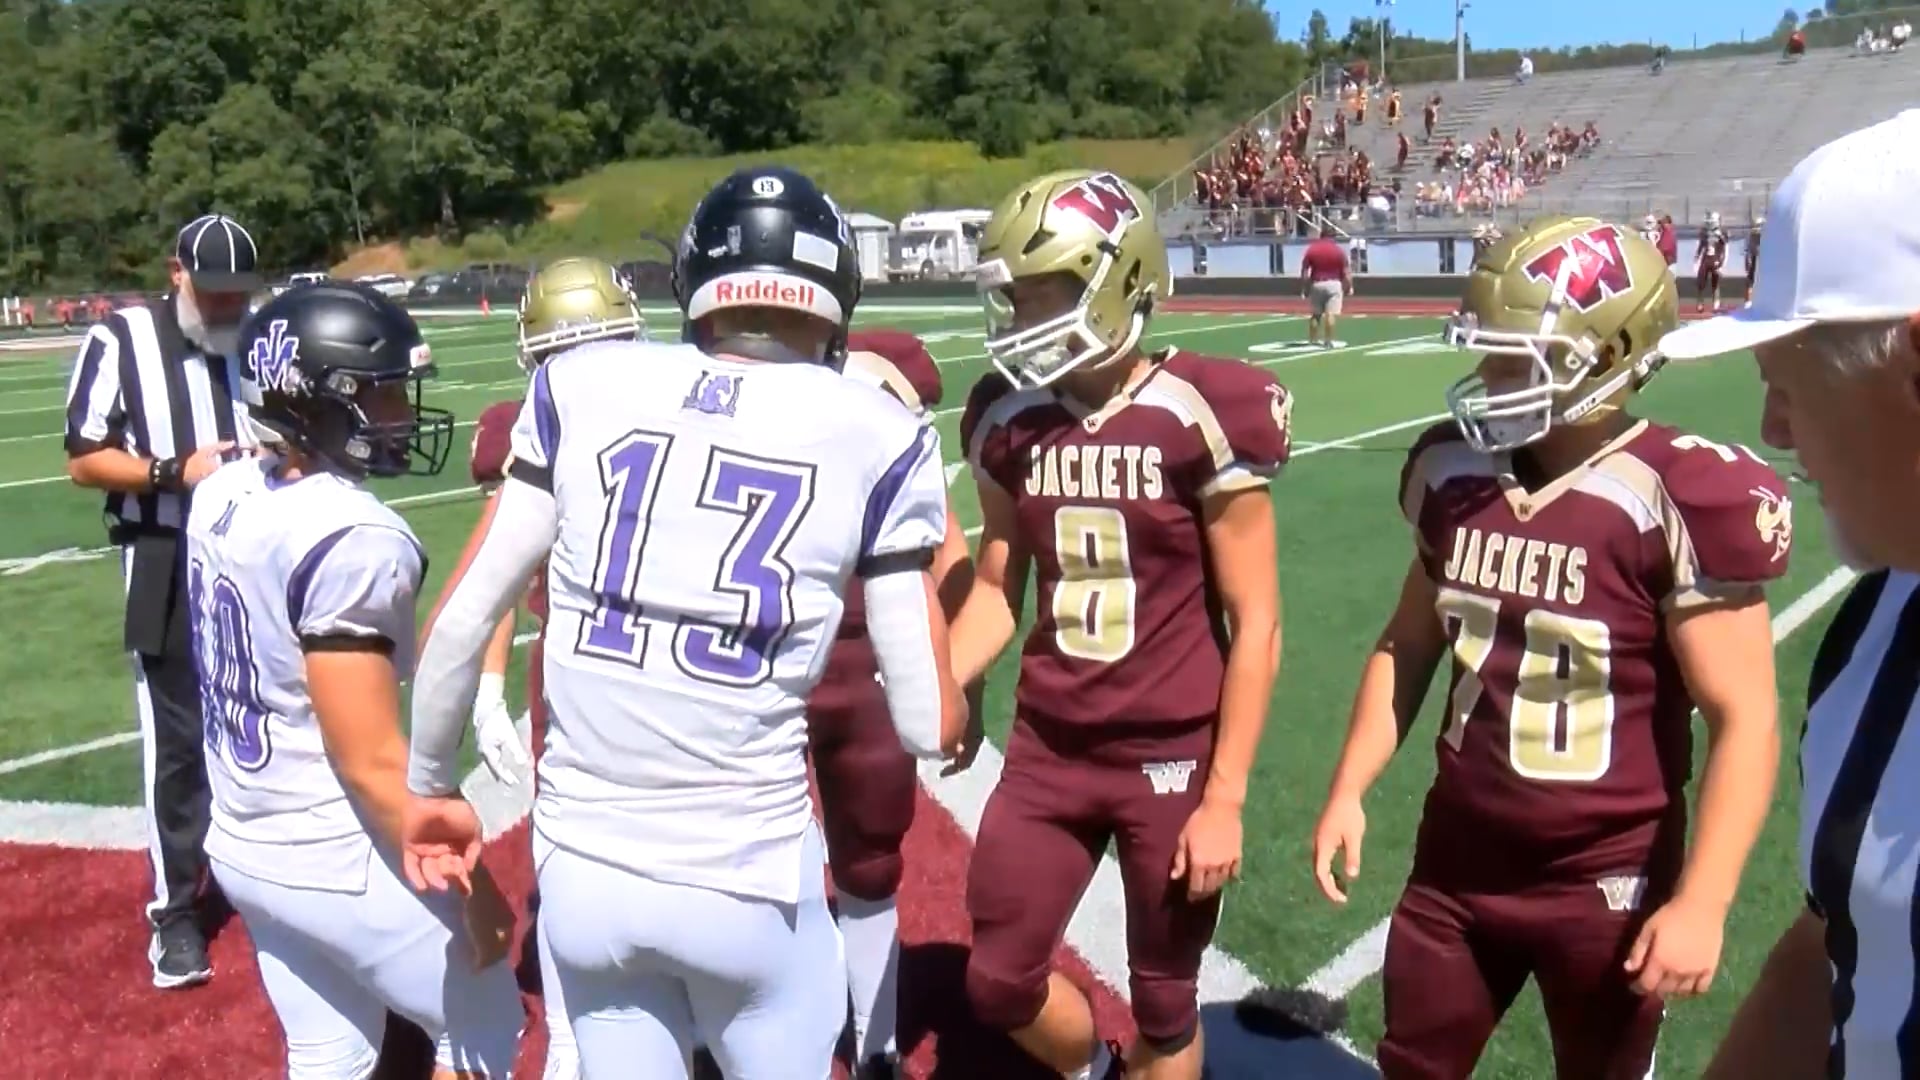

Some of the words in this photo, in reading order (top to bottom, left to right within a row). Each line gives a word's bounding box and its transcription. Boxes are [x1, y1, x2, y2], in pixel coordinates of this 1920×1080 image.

[760, 180, 775, 193] 13
[716, 279, 815, 307] Riddell
[1025, 444, 1163, 500] JACKETS
[573, 428, 818, 689] 13
[1053, 505, 1137, 663] 8
[1444, 526, 1588, 606] JACKETS
[1434, 586, 1615, 781] 78
[1142, 760, 1197, 794] W
[1596, 875, 1648, 911] W
